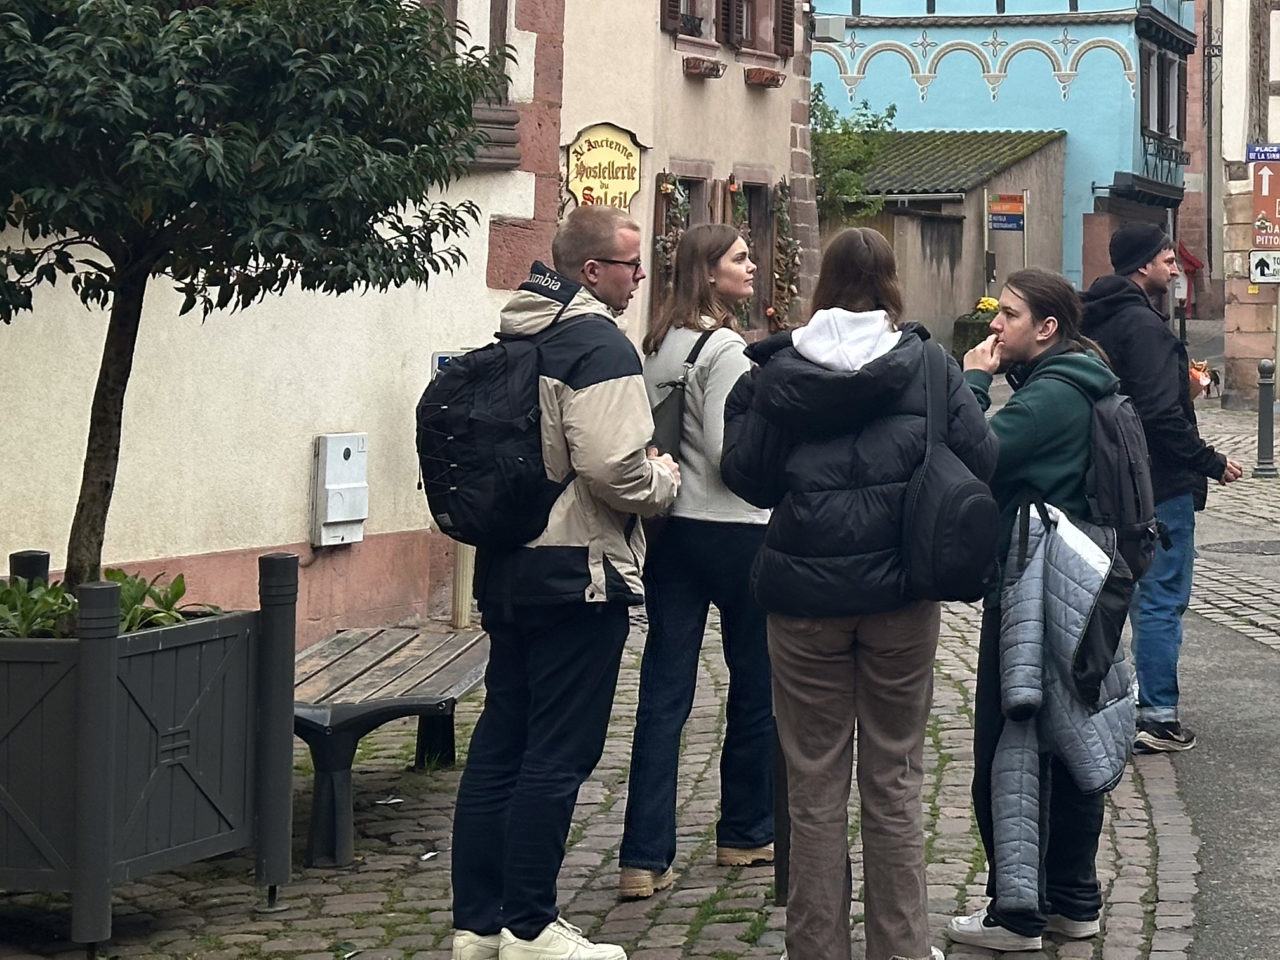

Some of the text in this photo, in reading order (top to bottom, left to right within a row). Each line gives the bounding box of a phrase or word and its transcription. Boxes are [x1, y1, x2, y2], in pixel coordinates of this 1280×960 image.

[1257, 152, 1266, 160] LA
[600, 181, 609, 190] du
[581, 186, 628, 209] Soleil
